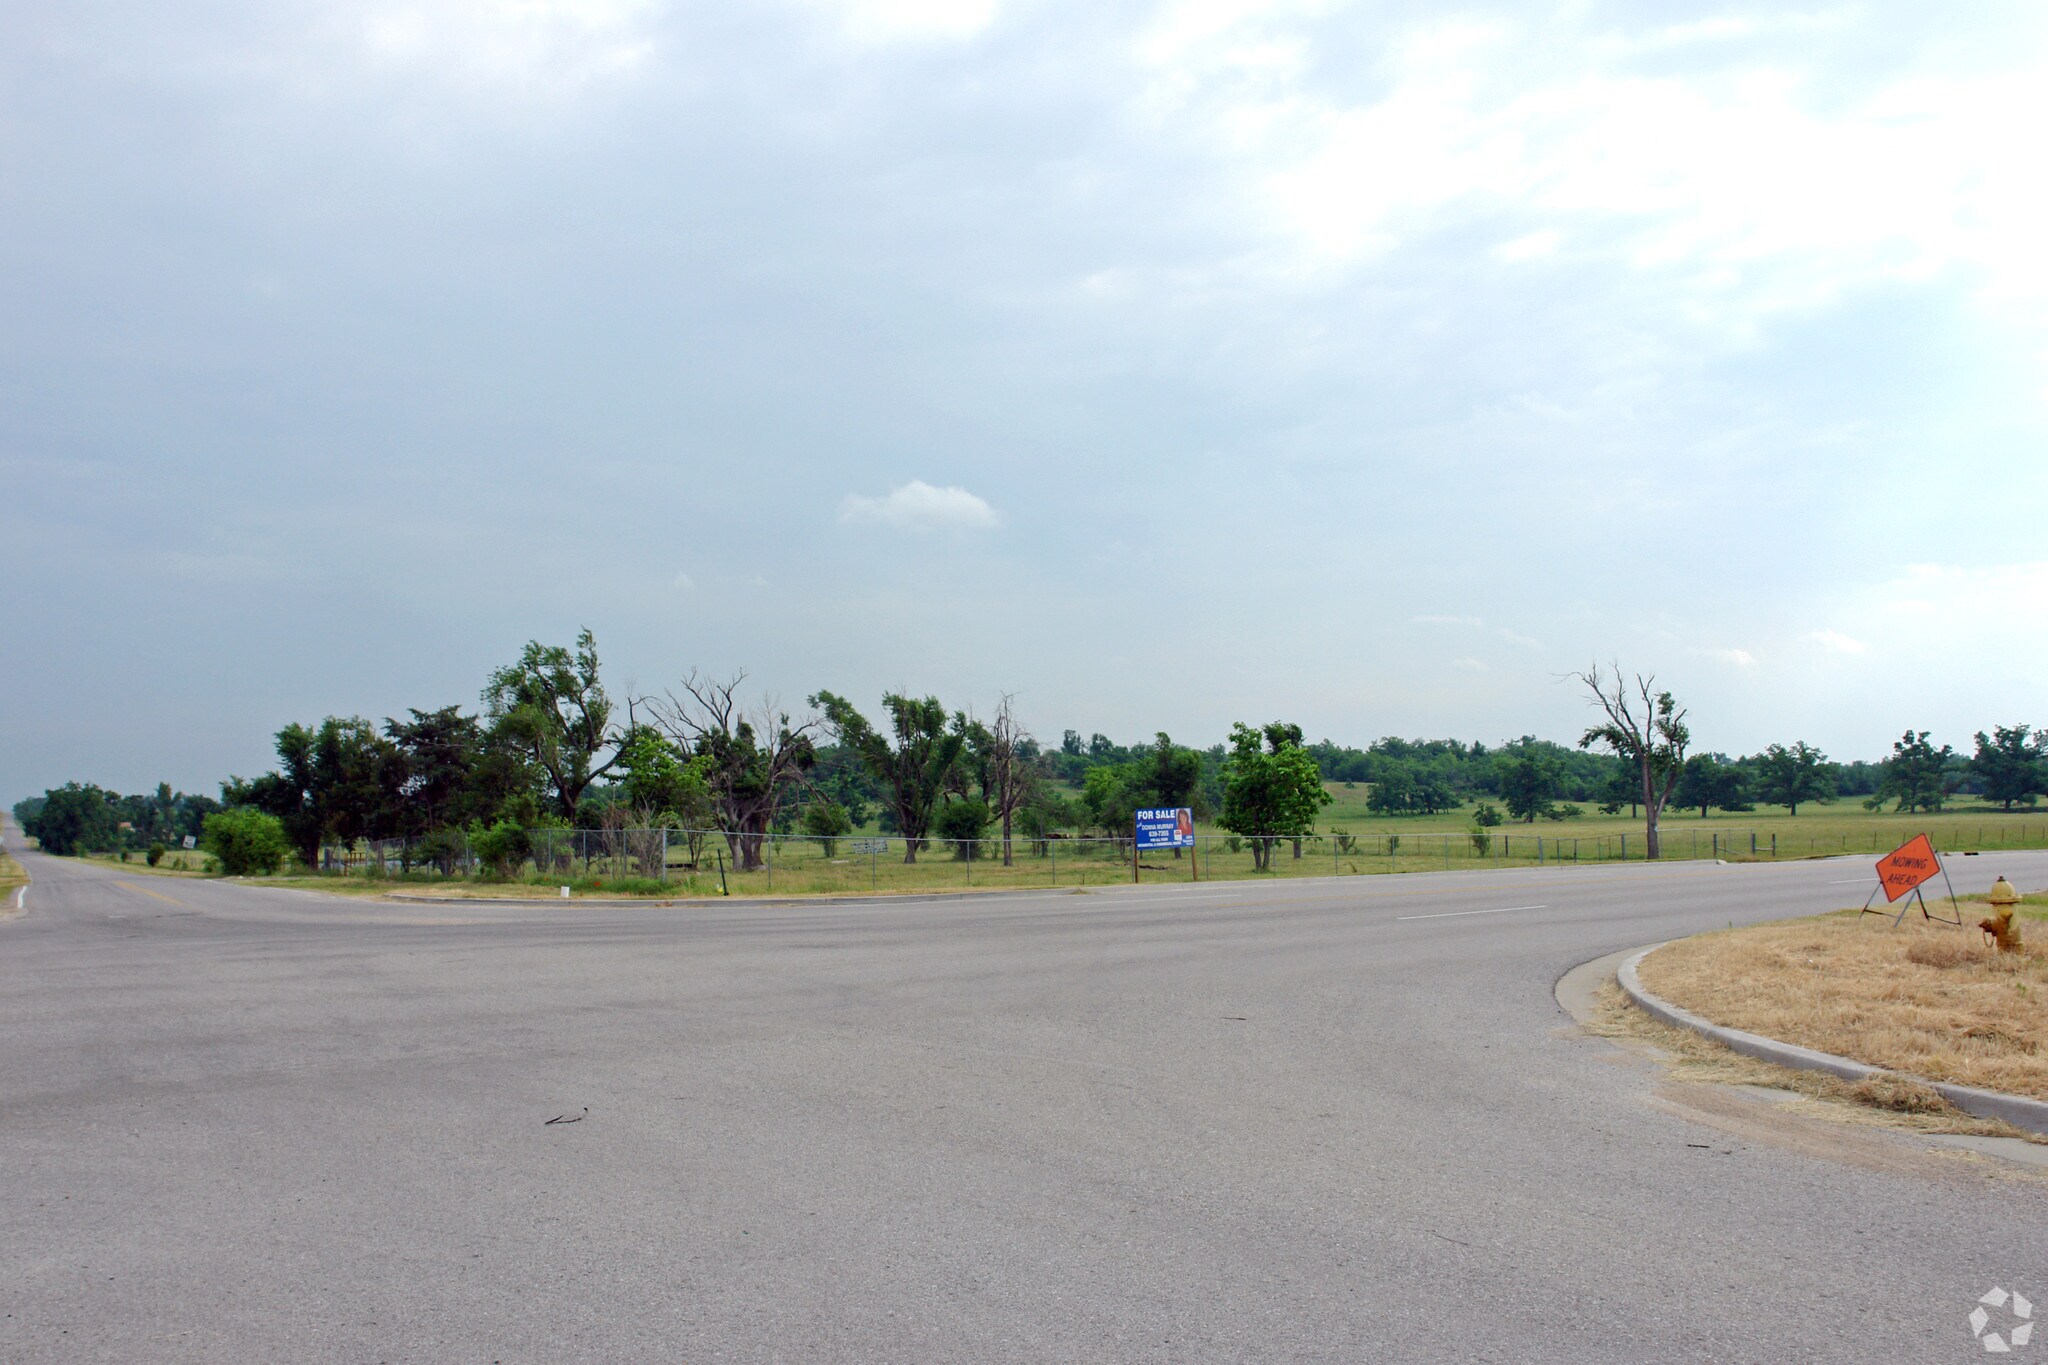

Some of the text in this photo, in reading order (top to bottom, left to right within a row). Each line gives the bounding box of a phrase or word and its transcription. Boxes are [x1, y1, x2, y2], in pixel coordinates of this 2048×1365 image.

[1137, 810, 1176, 820] FOR SALE
[1891, 856, 1928, 870] MOWING
[1887, 874, 1918, 886] AHEAD
